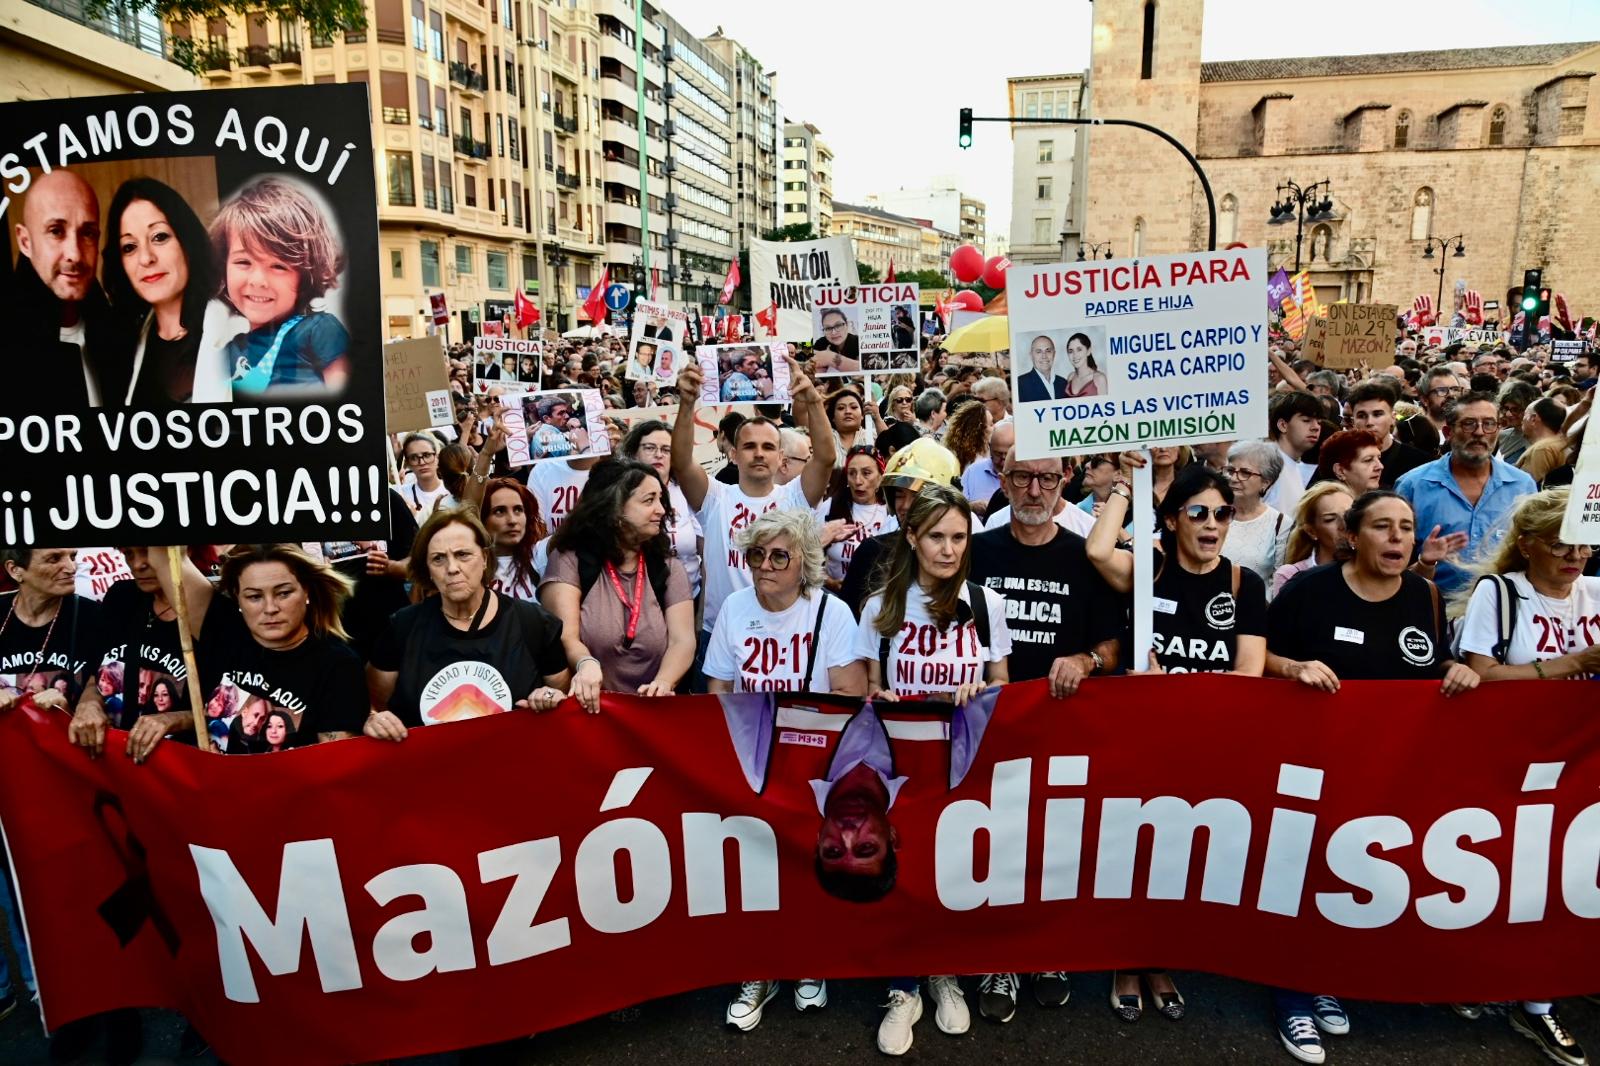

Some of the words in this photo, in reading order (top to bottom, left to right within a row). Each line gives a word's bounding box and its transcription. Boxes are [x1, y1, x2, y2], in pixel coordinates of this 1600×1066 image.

[0, 104, 196, 220] STAMOS
[215, 107, 357, 186] AQUÍ
[776, 248, 832, 281] MAZÓN
[1024, 263, 1161, 299] JUSTICIA
[1169, 257, 1251, 288] PARA
[814, 285, 917, 306] JUSTICIA
[1085, 298, 1139, 316] PADRE
[1144, 297, 1153, 311] E
[1158, 294, 1194, 309] HIJA
[1329, 304, 1349, 320] ON
[1352, 305, 1397, 321] ESTAVES
[1109, 332, 1176, 356] MIGUEL
[1180, 326, 1247, 349] CARPIO
[1250, 324, 1263, 343] Y
[1328, 322, 1341, 337] EL
[476, 339, 540, 353] JUSTICIA
[1127, 358, 1176, 381] SARA
[1180, 352, 1246, 375] CARPIO
[1034, 408, 1046, 424] Y
[1052, 402, 1116, 422] TODAS
[1122, 397, 1158, 416] LAS
[1163, 389, 1250, 412] VICTIMAS
[98, 403, 365, 451] VOSOTROS
[1049, 420, 1130, 448] MAZÓN
[1136, 411, 1236, 440] DIMISIÓN
[49, 464, 382, 530] JUSTICIA!!!
[1003, 576, 1026, 591] UNA
[1026, 578, 1070, 596] ESCOLA
[1001, 594, 1062, 624] BLICA
[898, 620, 977, 658] 20:11
[1009, 629, 1057, 645] UALITAT
[1152, 632, 1231, 662] SARA
[0, 651, 45, 672] AMOS
[741, 631, 813, 677] 20:11
[424, 666, 461, 701] VERDAD
[463, 664, 471, 676] Y
[473, 665, 507, 701] JUSTICIA
[896, 658, 916, 685] NI
[920, 662, 979, 686] OBLIT
[188, 766, 781, 1004] Mazón
